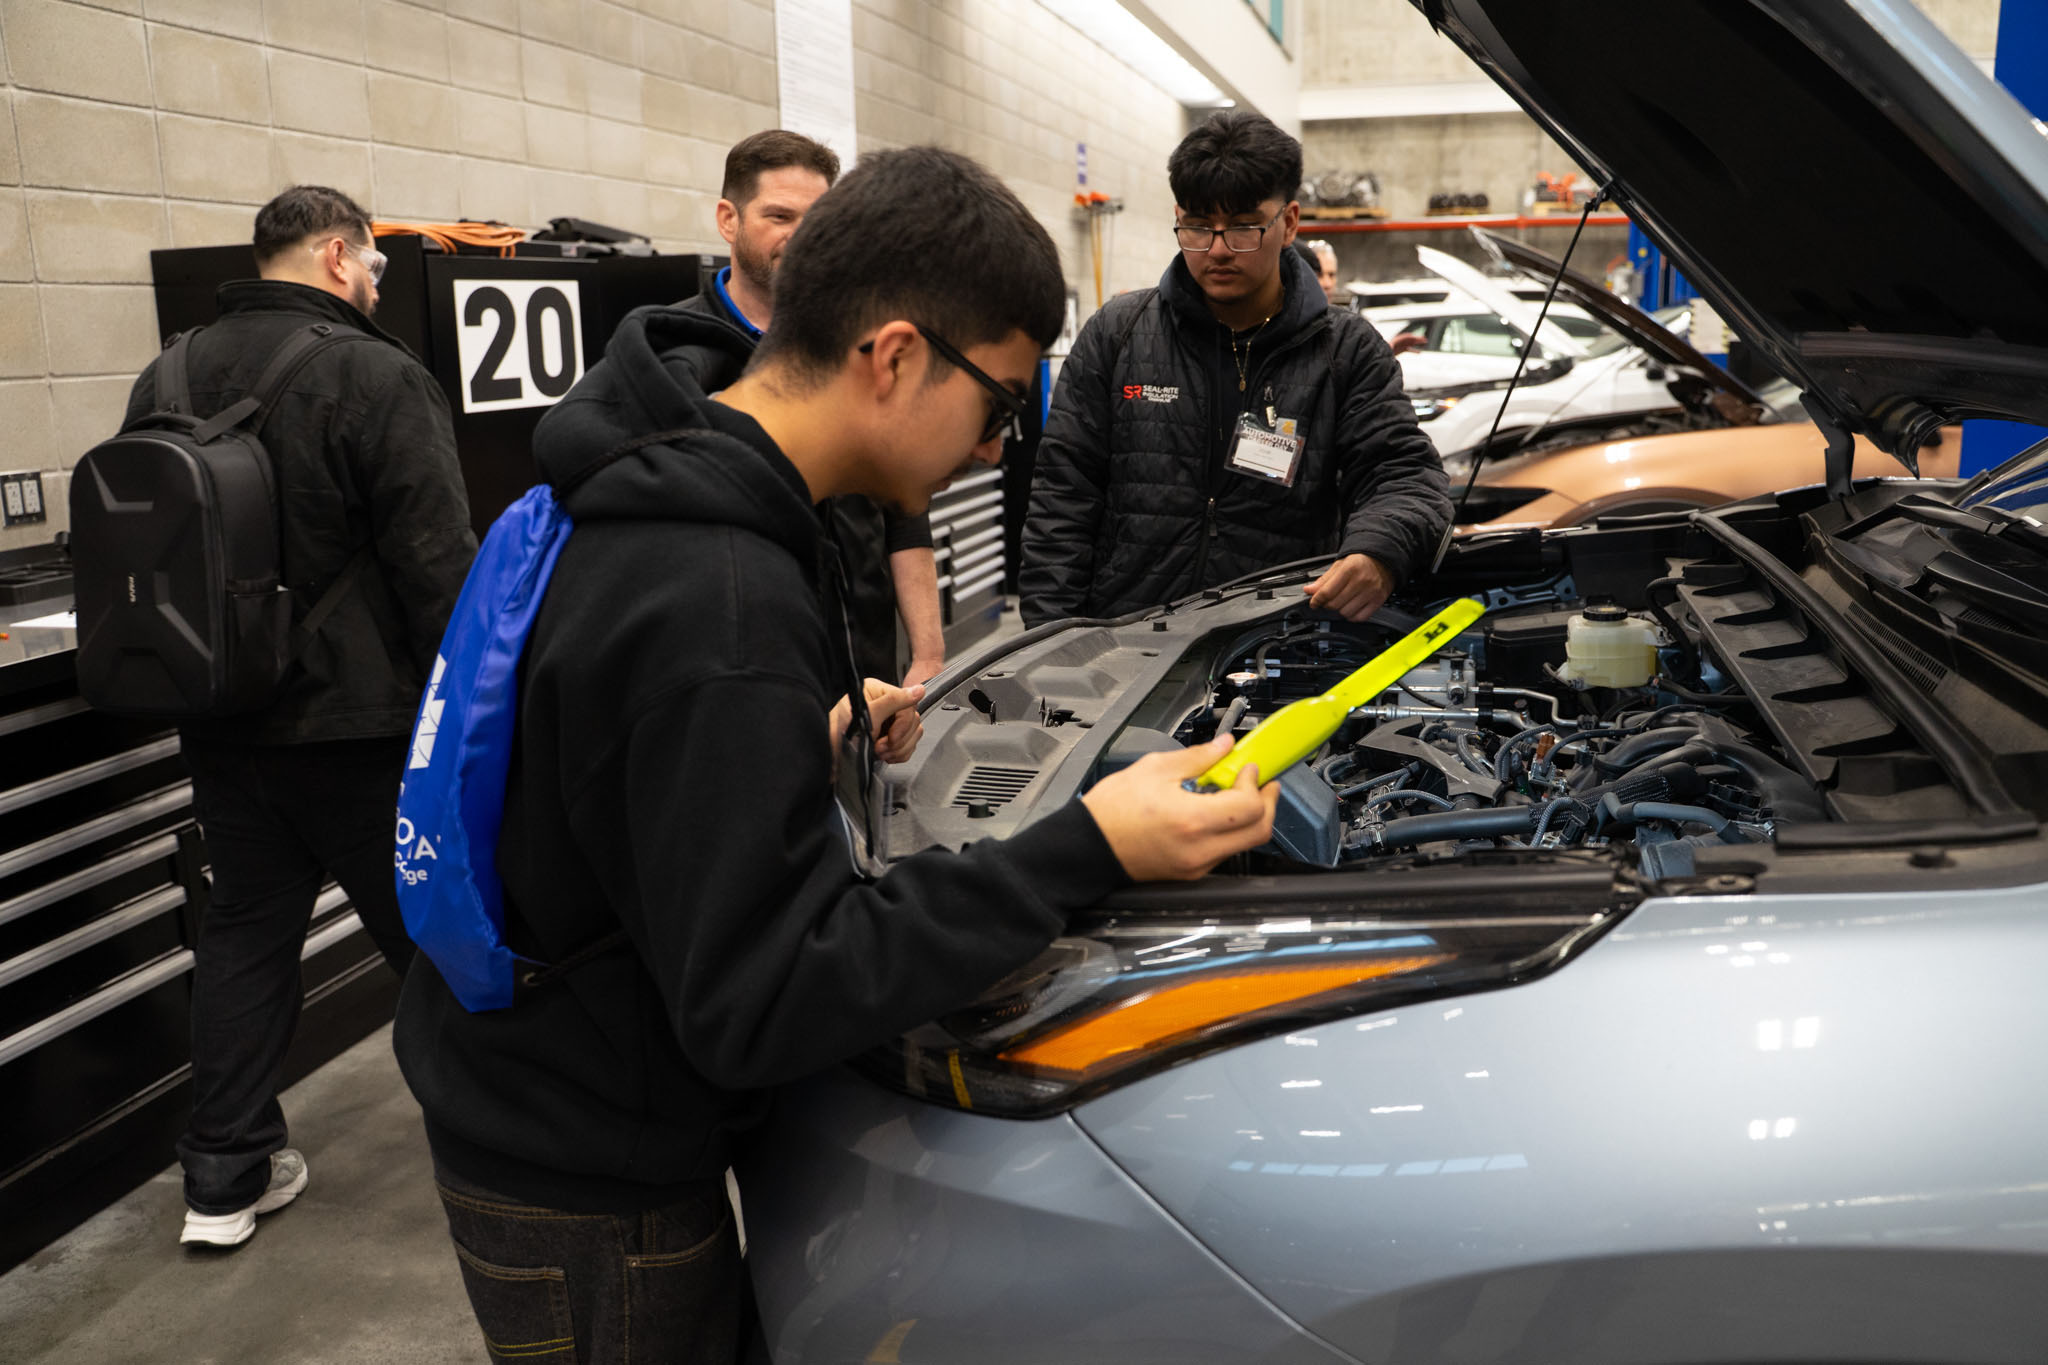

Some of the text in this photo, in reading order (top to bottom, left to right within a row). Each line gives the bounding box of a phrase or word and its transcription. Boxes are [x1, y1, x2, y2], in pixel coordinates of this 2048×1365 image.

[464, 286, 577, 403] 20
[1123, 385, 1142, 399] SR
[1143, 385, 1179, 394] SEAL-RITE
[1243, 427, 1297, 448] AUTOMOTIVE
